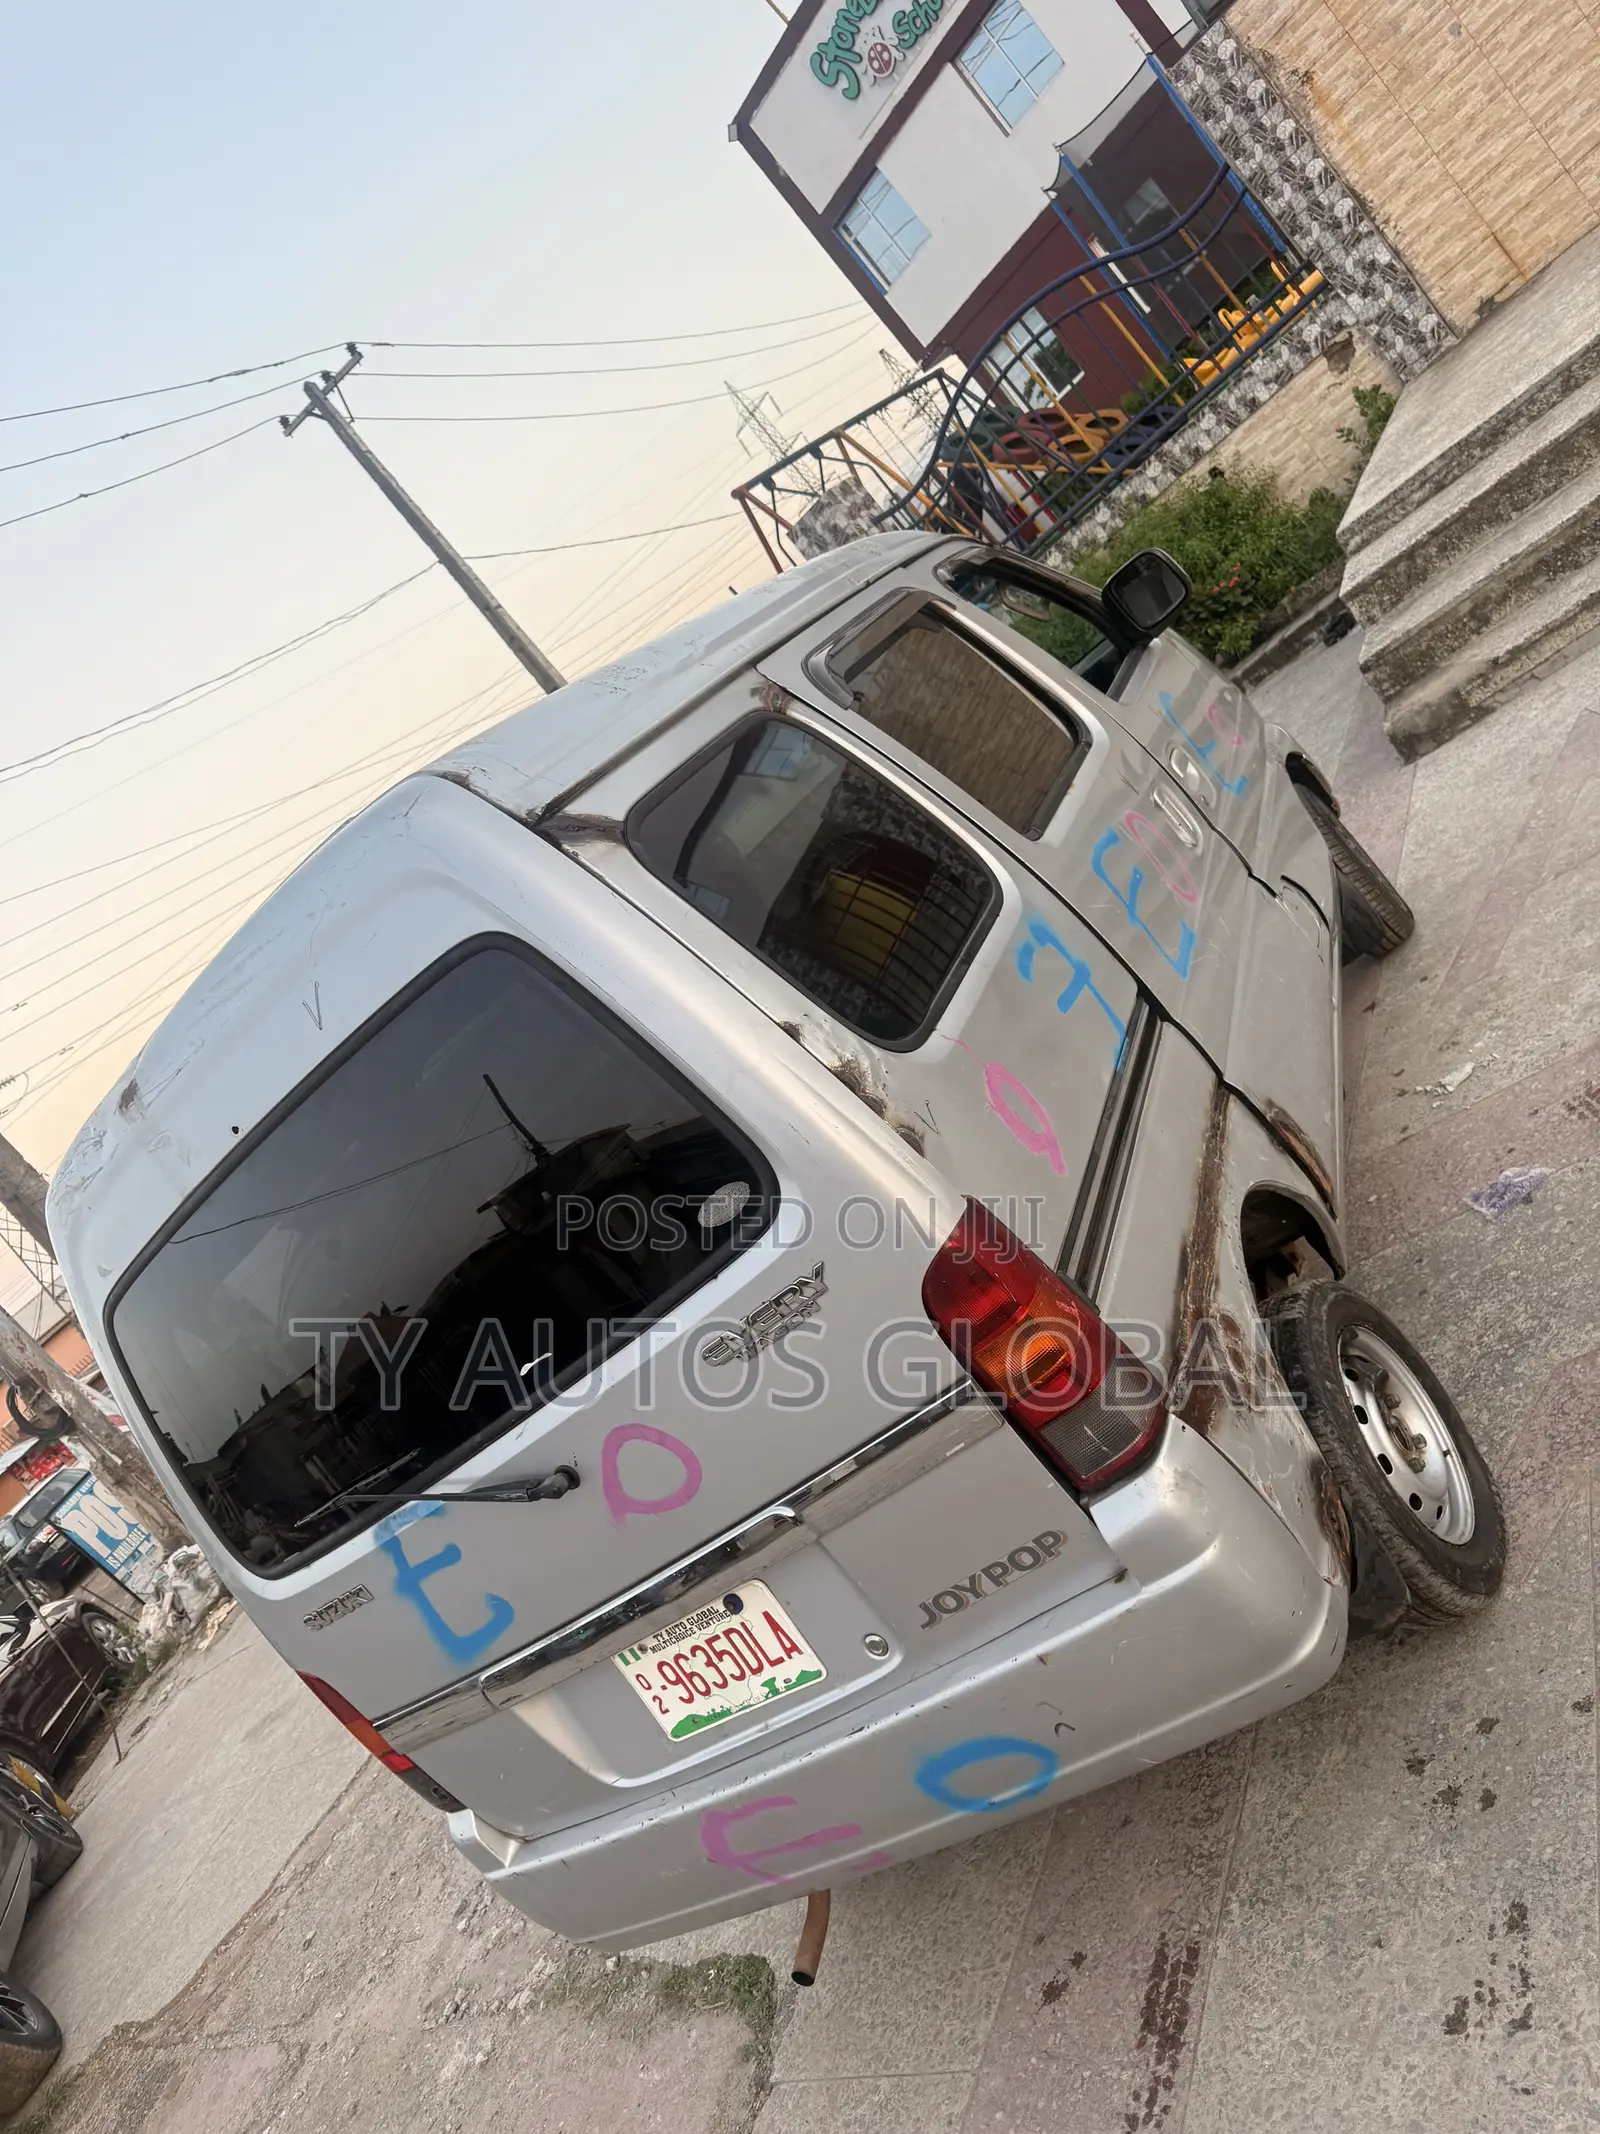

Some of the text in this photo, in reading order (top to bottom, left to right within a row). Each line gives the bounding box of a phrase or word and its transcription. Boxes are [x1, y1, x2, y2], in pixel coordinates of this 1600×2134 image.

[701, 1261, 828, 1367] EVERY
[918, 1529, 1068, 1630] JOYPOP
[303, 1584, 374, 1631] SUZUKI
[652, 1606, 719, 1643] TY AUTO GLOBAL
[649, 1609, 733, 1654] MULTICHOICE VENTURE
